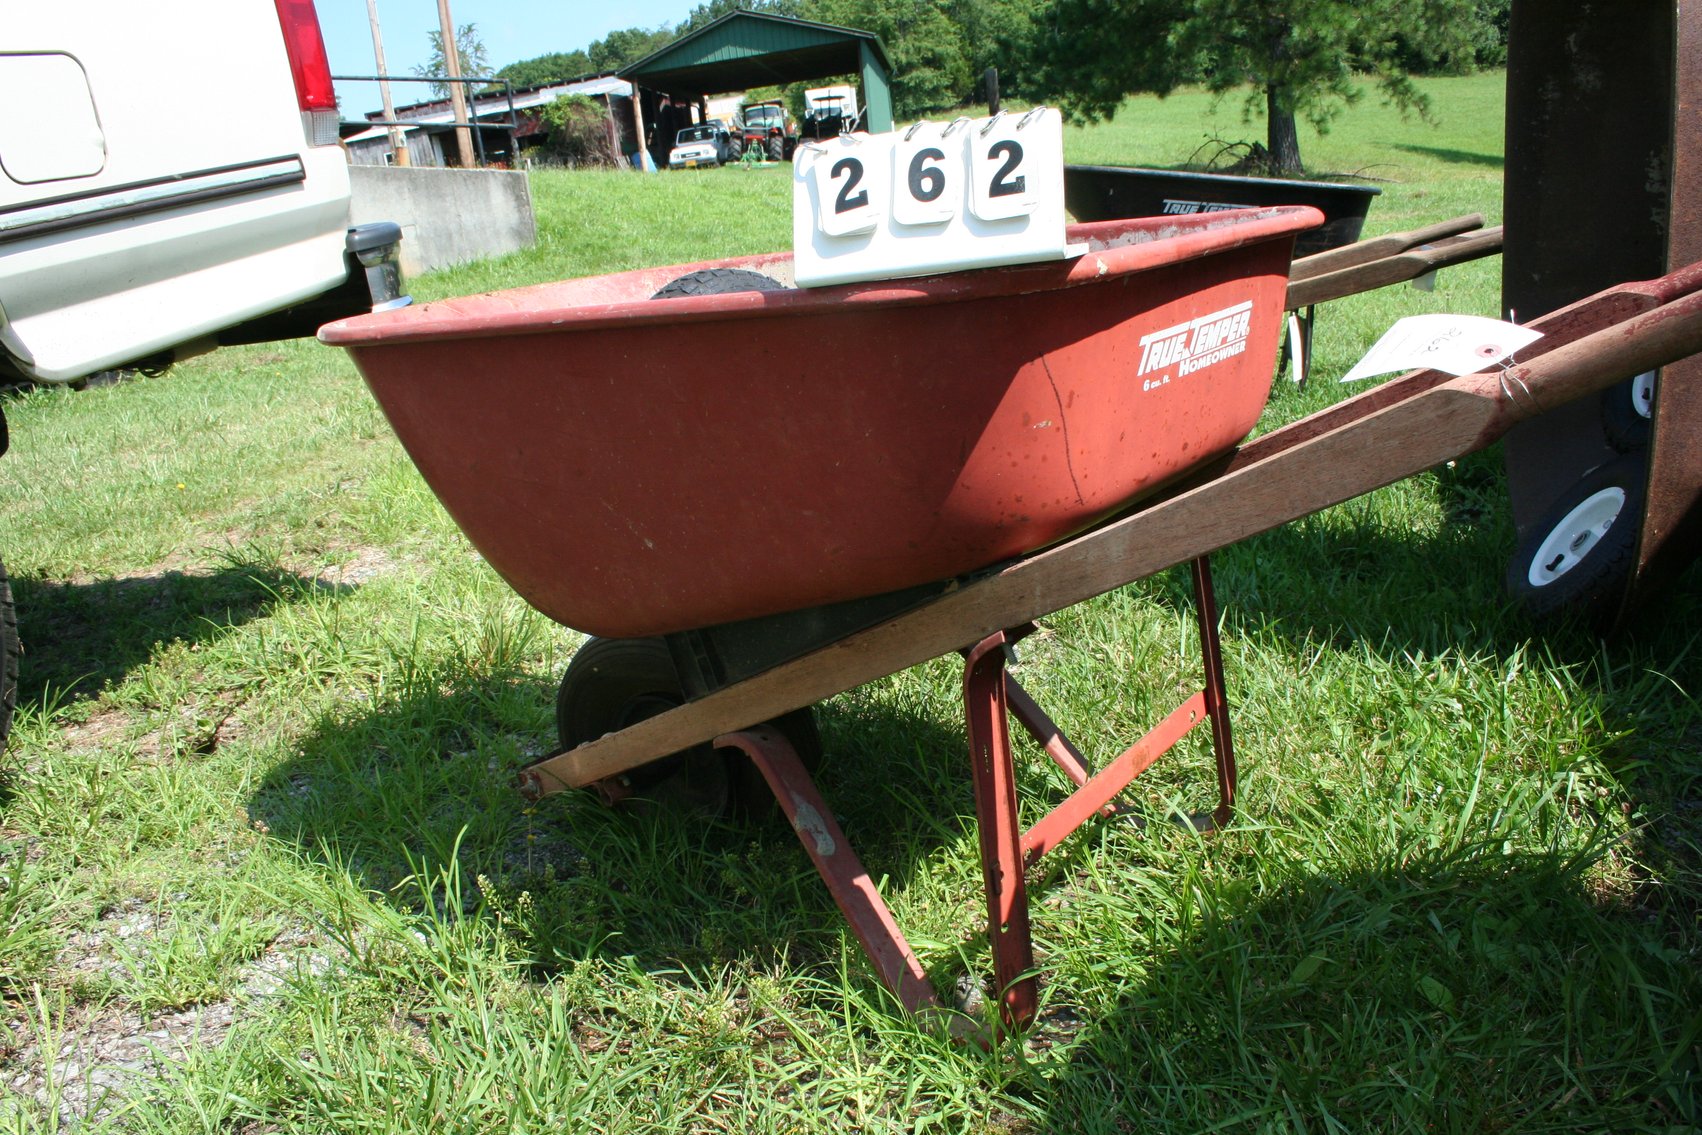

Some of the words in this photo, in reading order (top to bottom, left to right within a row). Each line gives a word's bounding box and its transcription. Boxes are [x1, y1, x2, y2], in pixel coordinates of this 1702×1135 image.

[1163, 199, 1201, 215] TRUE
[1137, 320, 1192, 377] TRUE
[1189, 300, 1253, 356] TEMPER
[1178, 340, 1247, 378] HOMEOWNER
[1143, 379, 1150, 392] 6
